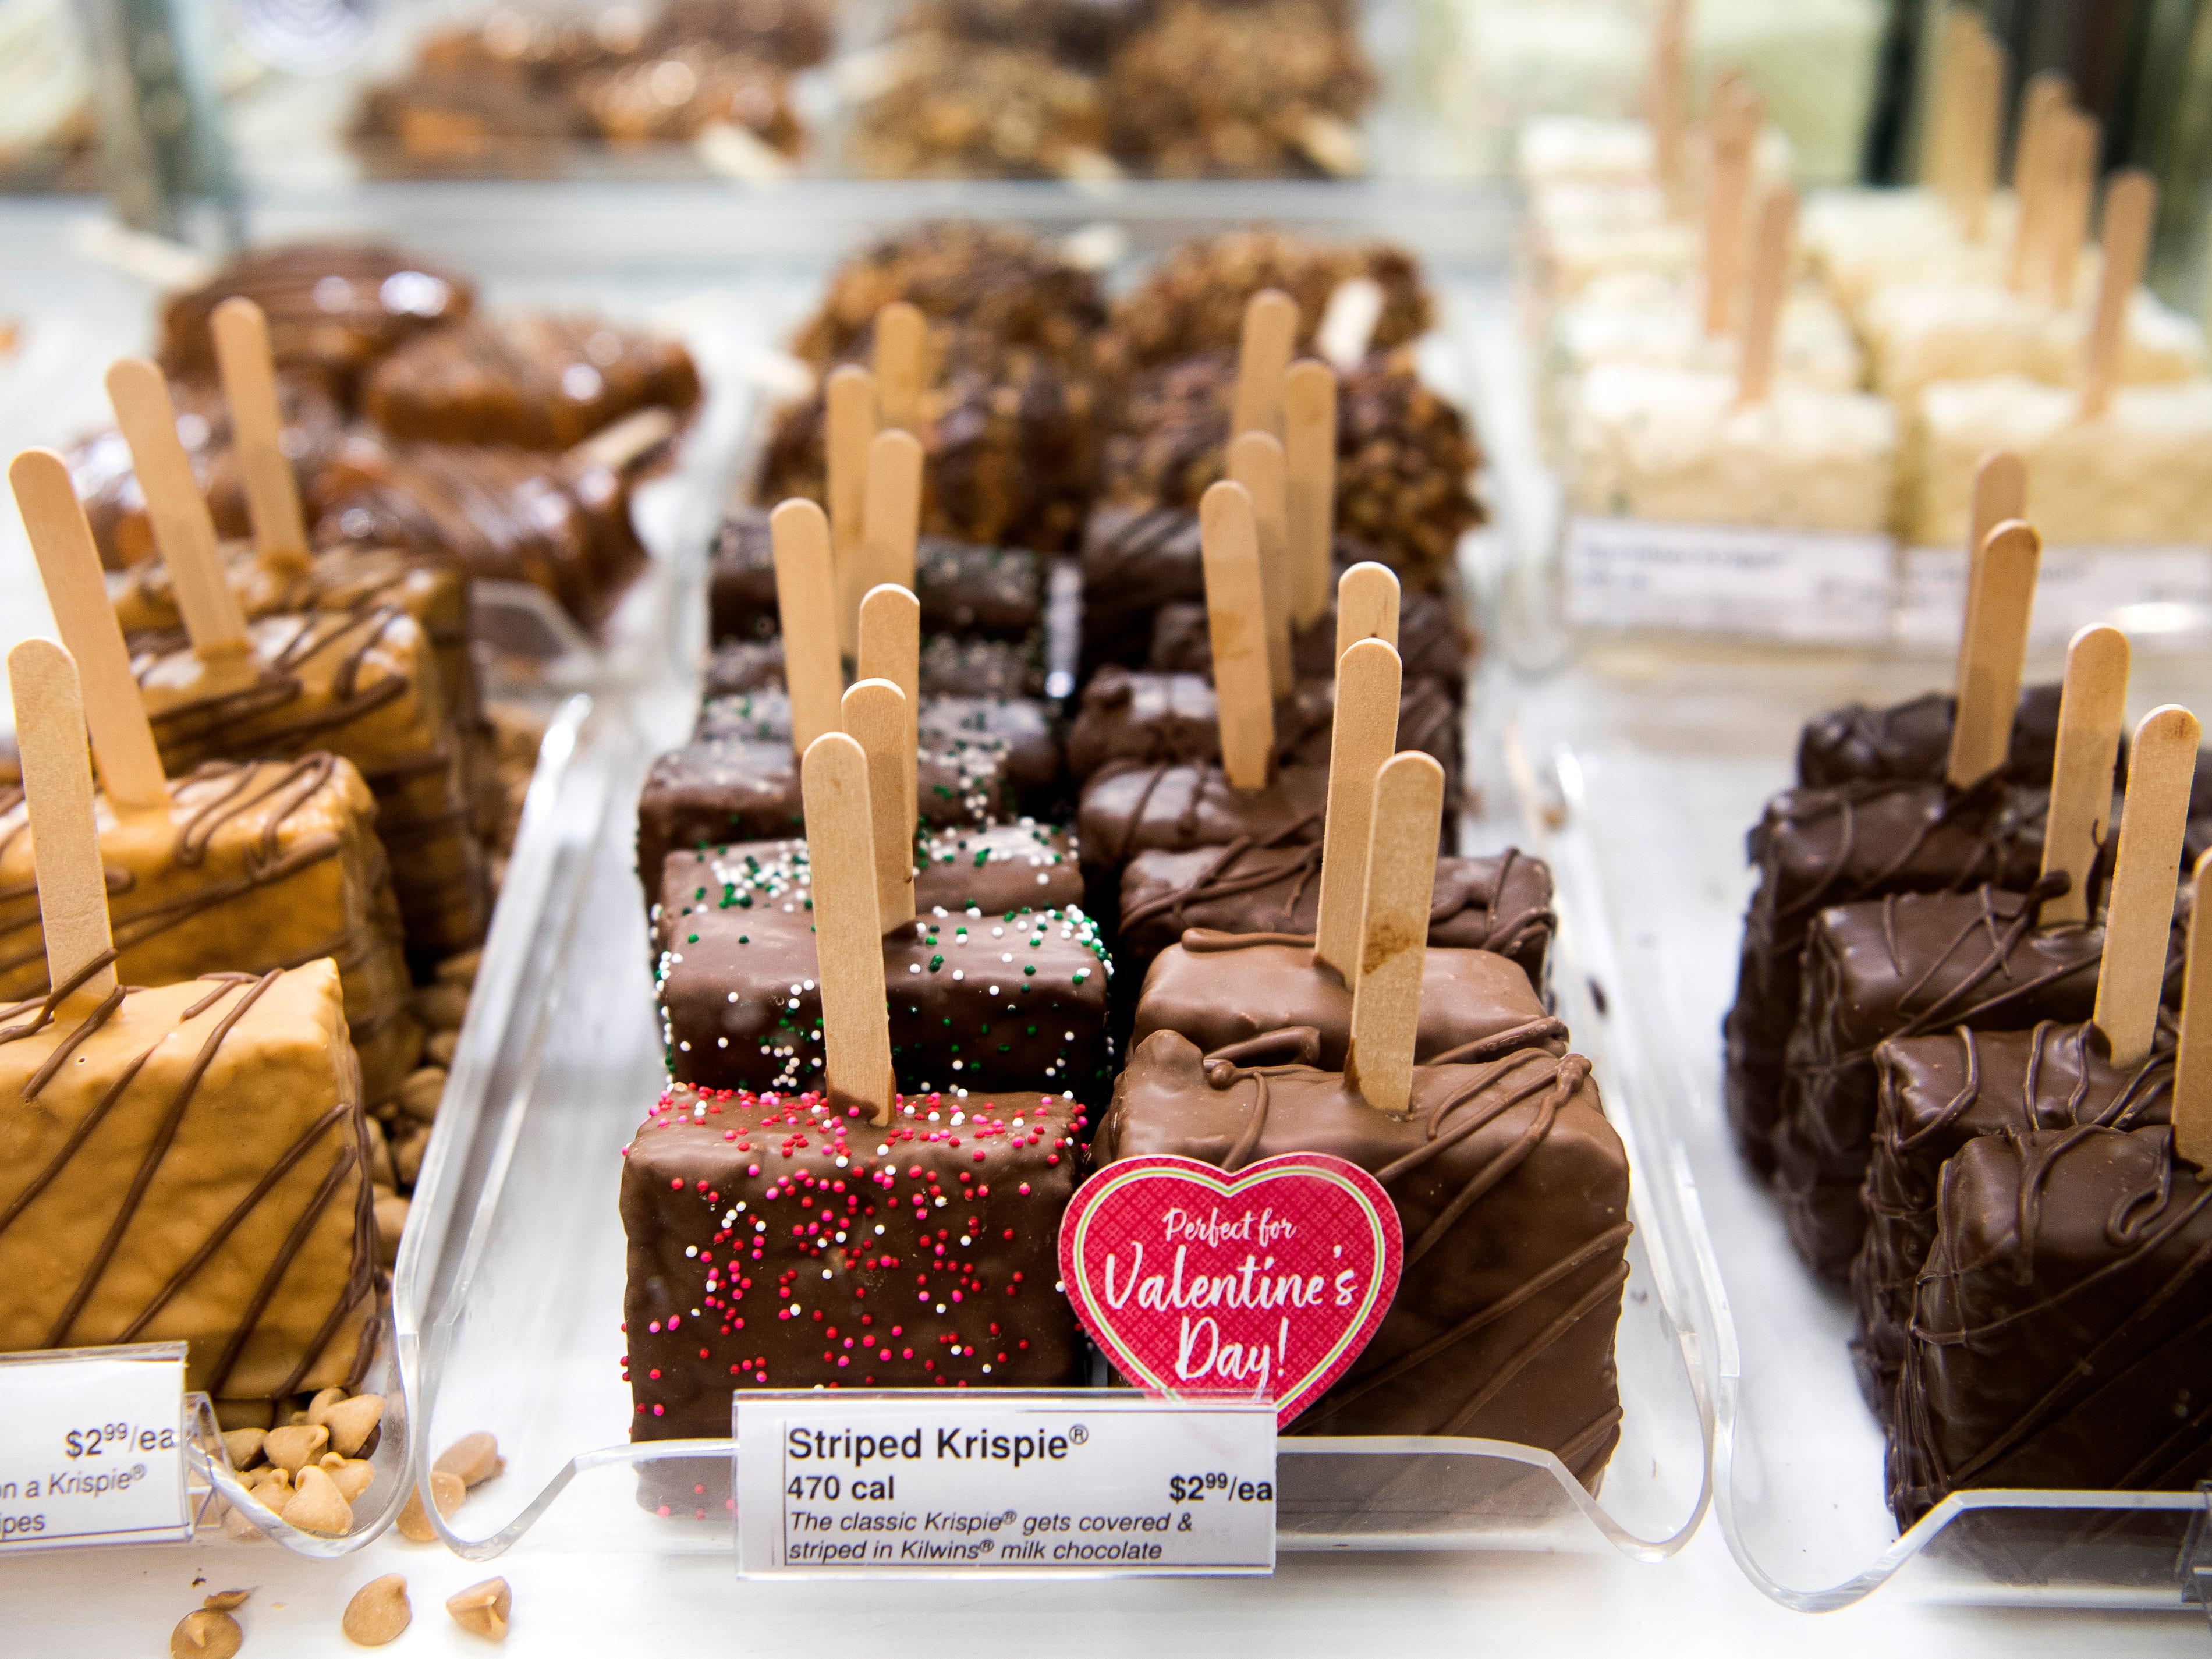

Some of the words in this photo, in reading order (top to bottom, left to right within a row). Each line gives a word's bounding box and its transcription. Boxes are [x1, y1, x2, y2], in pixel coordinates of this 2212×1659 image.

[1162, 1207, 1255, 1247] Perfect
[1258, 1207, 1297, 1247] for
[1106, 1241, 1358, 1310] Valentine's
[1175, 1316, 1289, 1403] Day!
[788, 1428, 921, 1467] Striped
[938, 1424, 1089, 1467] Krispie®
[0, 1483, 16, 1500] n
[24, 1480, 39, 1499] a
[788, 1476, 840, 1500] 470
[852, 1475, 894, 1500] cal
[0, 1514, 46, 1541] pes
[791, 1511, 832, 1530] The
[840, 1511, 917, 1531] classic
[1023, 1513, 1070, 1536] gets
[1079, 1512, 1172, 1532] covered
[1177, 1512, 1192, 1532] &
[789, 1540, 866, 1564] striped
[873, 1540, 892, 1559] in
[1001, 1540, 1045, 1559] milk
[1053, 1540, 1162, 1559] chocolate
